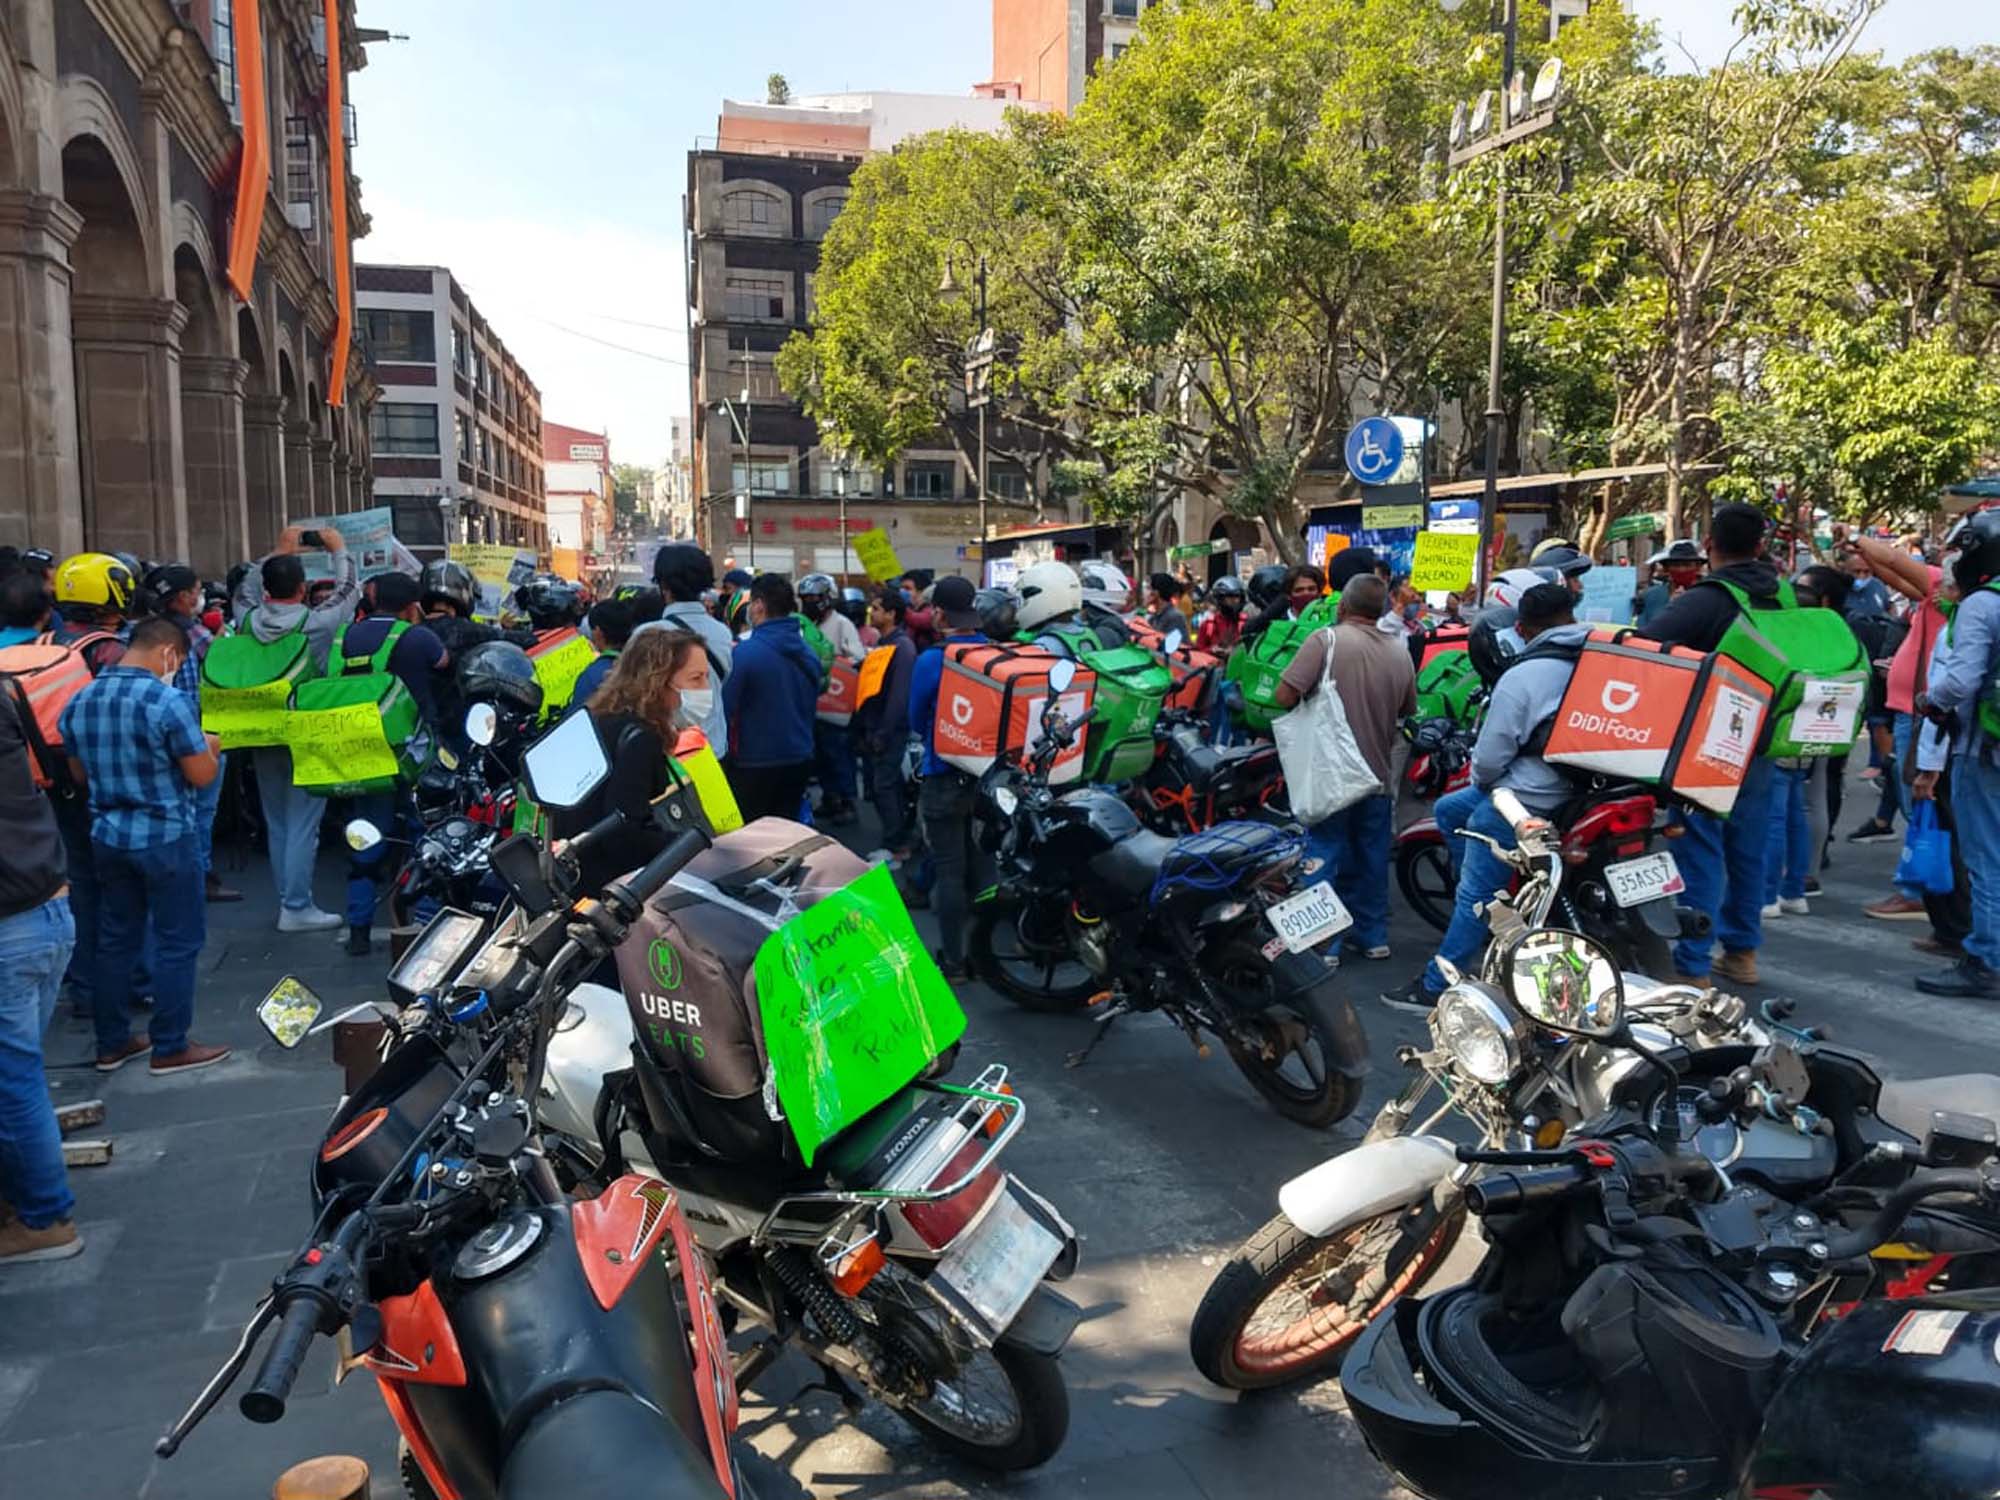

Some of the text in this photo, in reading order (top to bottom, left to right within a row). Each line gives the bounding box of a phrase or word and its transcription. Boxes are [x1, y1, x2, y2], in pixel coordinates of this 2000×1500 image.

[1617, 864, 1670, 893] 35ASS7
[1281, 898, 1336, 936] 89DAU5
[640, 992, 701, 1027] UBER
[648, 1023, 705, 1059] EATS
[883, 1117, 930, 1164] HONDA
